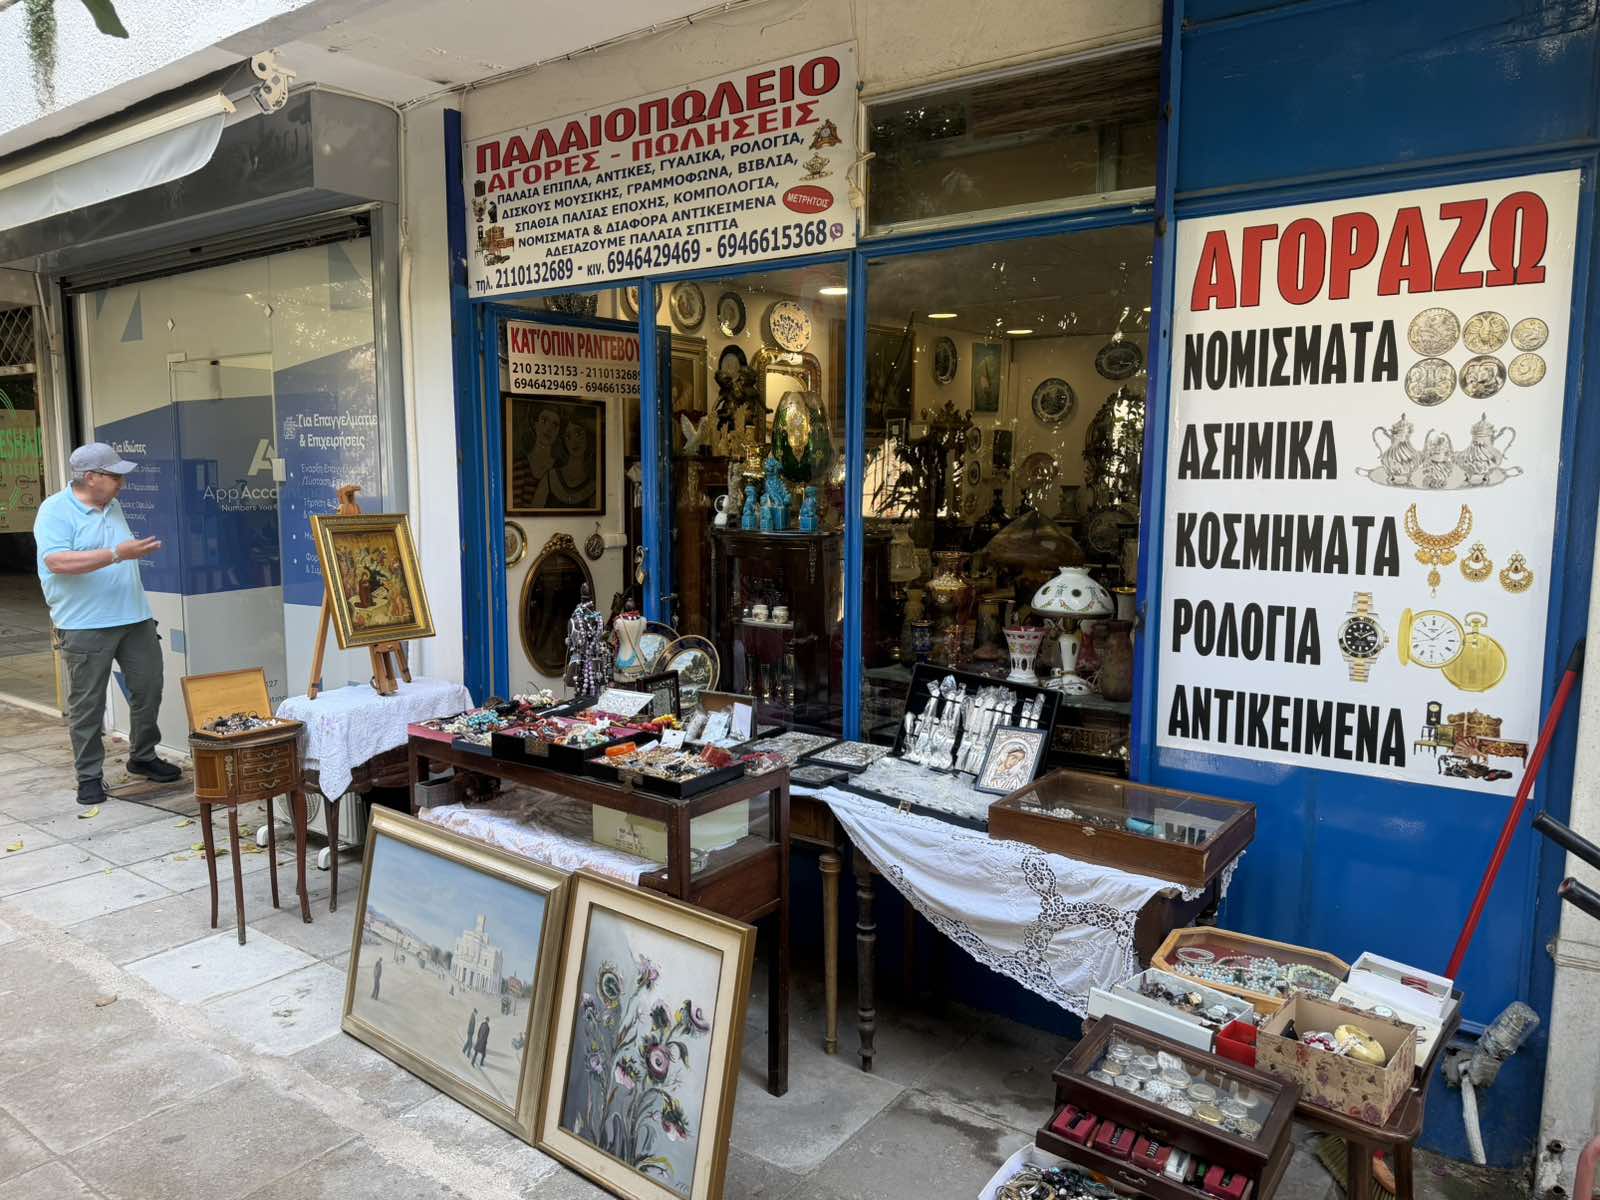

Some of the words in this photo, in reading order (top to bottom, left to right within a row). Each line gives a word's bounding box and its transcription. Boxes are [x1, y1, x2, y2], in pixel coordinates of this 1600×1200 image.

[476, 56, 841, 174] ΠΑΛΑΙΟΠΩΛΕΙΟ
[488, 151, 601, 193] ΑΓΟΡΕΣ
[632, 100, 820, 161] ΠΩΛΗΣΕΙΣ
[497, 187, 540, 205] ΠΑΛΑΙΑ
[543, 177, 592, 195] ΕΠΙΠΛΑ,
[596, 163, 656, 184] ΑΝΤΙΚΕΣ,
[660, 148, 725, 171] ΓΥΑΛΙΚΑ,
[730, 132, 805, 156] ΡΟΛΟΓΙΑ,
[502, 202, 552, 219] ΔΙΣΚΟΥΣ
[555, 187, 622, 209] ΜΟΥΣΙΚΗΣ,
[627, 166, 733, 195] ΓΡΑΜΜΟΦΩΝΑ,
[738, 153, 798, 174] ΒΙΒΛΙΑ,
[515, 215, 559, 232] ΣΠΑΘΙΑ
[563, 207, 608, 224] ΠΑΛΙΑΣ
[612, 196, 669, 215] ΕΠΟΧΗΣ,
[674, 176, 779, 204] ΚΟΜΠΟΛΟΓΙΑ,
[518, 226, 590, 248] ΝΟΜΙΣΜΑΤΑ
[593, 224, 603, 235] &
[606, 212, 668, 233] ΔΙΑΦΟΡΑ
[672, 195, 776, 222] ΑΝΤΙΚΕΙΜΕΝΑ
[495, 258, 574, 289] 2110132689
[607, 239, 701, 274] 6946429469
[717, 219, 827, 259] 6946615368
[545, 235, 626, 258] ΑΔΕΙΑΖΟΥΜΕ
[630, 227, 682, 244] ΠΑΛΑΙΑ
[686, 218, 739, 235] ΣΠΙΤΙΑ
[1190, 190, 1548, 311] ΑΓΟΡΑΖΩ
[512, 362, 532, 374] 210
[534, 363, 578, 377] 2312153
[577, 333, 641, 362] ΡΑΝΤΕΒΟΥ
[1183, 319, 1399, 391] ΝΟΜΙΣΜΑΤΑ
[514, 377, 578, 391] 6946429469
[1177, 419, 1338, 481] ΑΣΗΜΙΚΑ
[1174, 511, 1400, 577] ΚΟΣΜΗΜΑΤΑ
[1171, 598, 1322, 667] ΡΟΛΟΓΙΑ
[1168, 684, 1406, 768] ΑΝΤΙΚΕΙΜΕΝΑ
